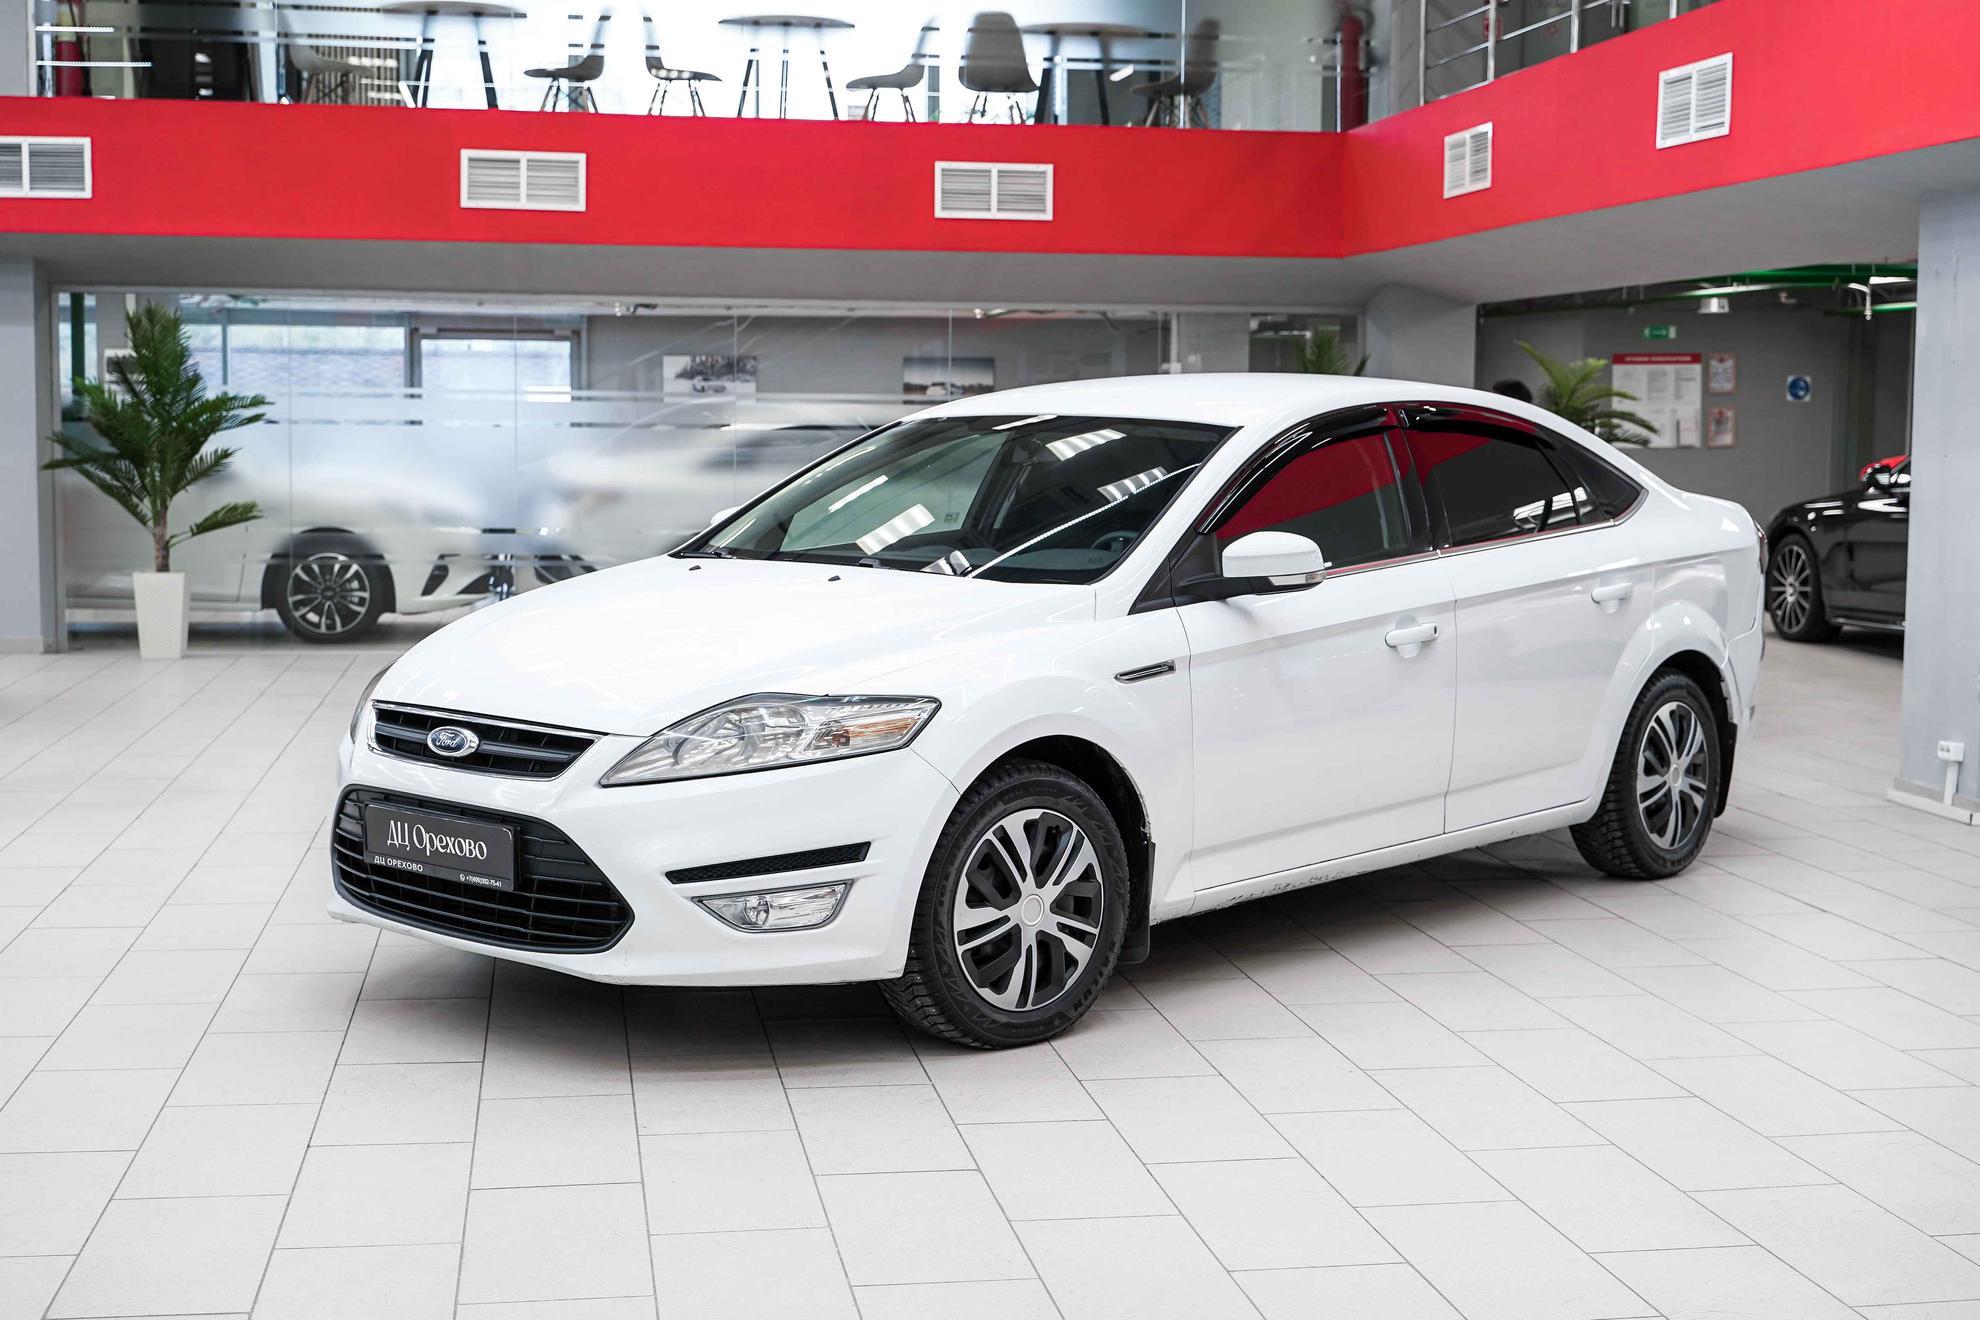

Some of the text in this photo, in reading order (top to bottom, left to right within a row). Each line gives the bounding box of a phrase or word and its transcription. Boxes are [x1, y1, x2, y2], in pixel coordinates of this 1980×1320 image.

[436, 732, 460, 748] Ford
[387, 820, 488, 860] ДЦ Орехово
[374, 855, 424, 872] ДЦ ОРЕХОВО
